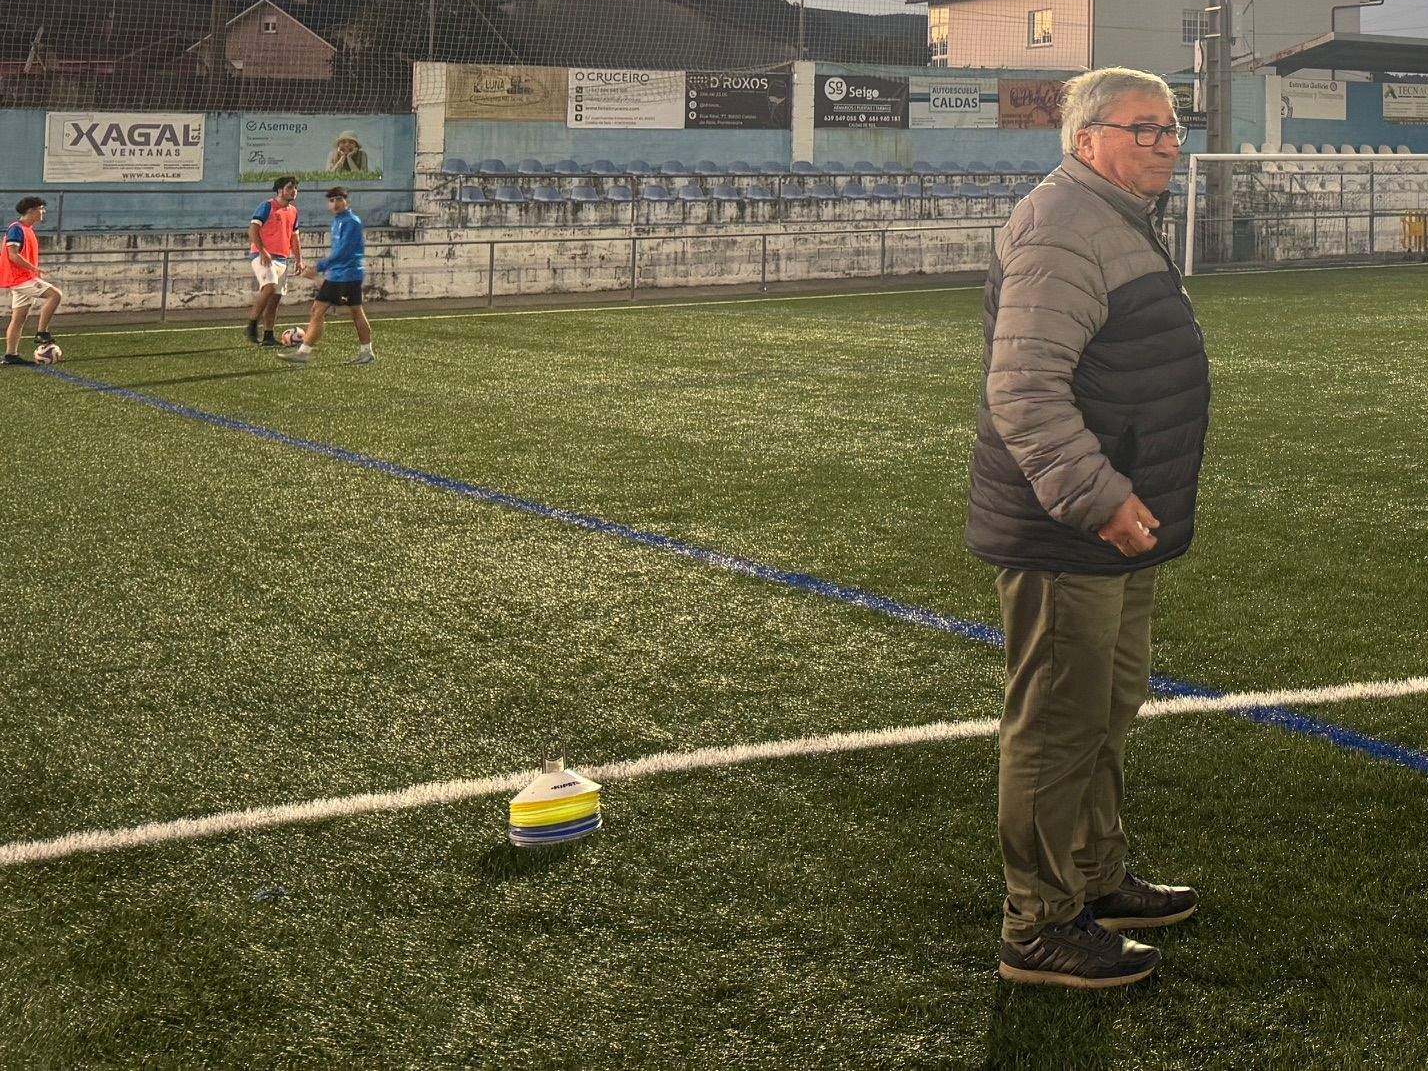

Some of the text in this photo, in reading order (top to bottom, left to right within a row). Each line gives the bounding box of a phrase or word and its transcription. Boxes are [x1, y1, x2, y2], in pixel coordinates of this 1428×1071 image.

[575, 71, 651, 86] O CRUCEIRO
[848, 86, 880, 100] Seigo
[931, 86, 978, 95] AUTOESCUELA
[932, 97, 978, 108] CALDAS
[259, 121, 309, 133] Asemega
[69, 123, 200, 156] XAGAL
[111, 148, 181, 157] VENTANAS
